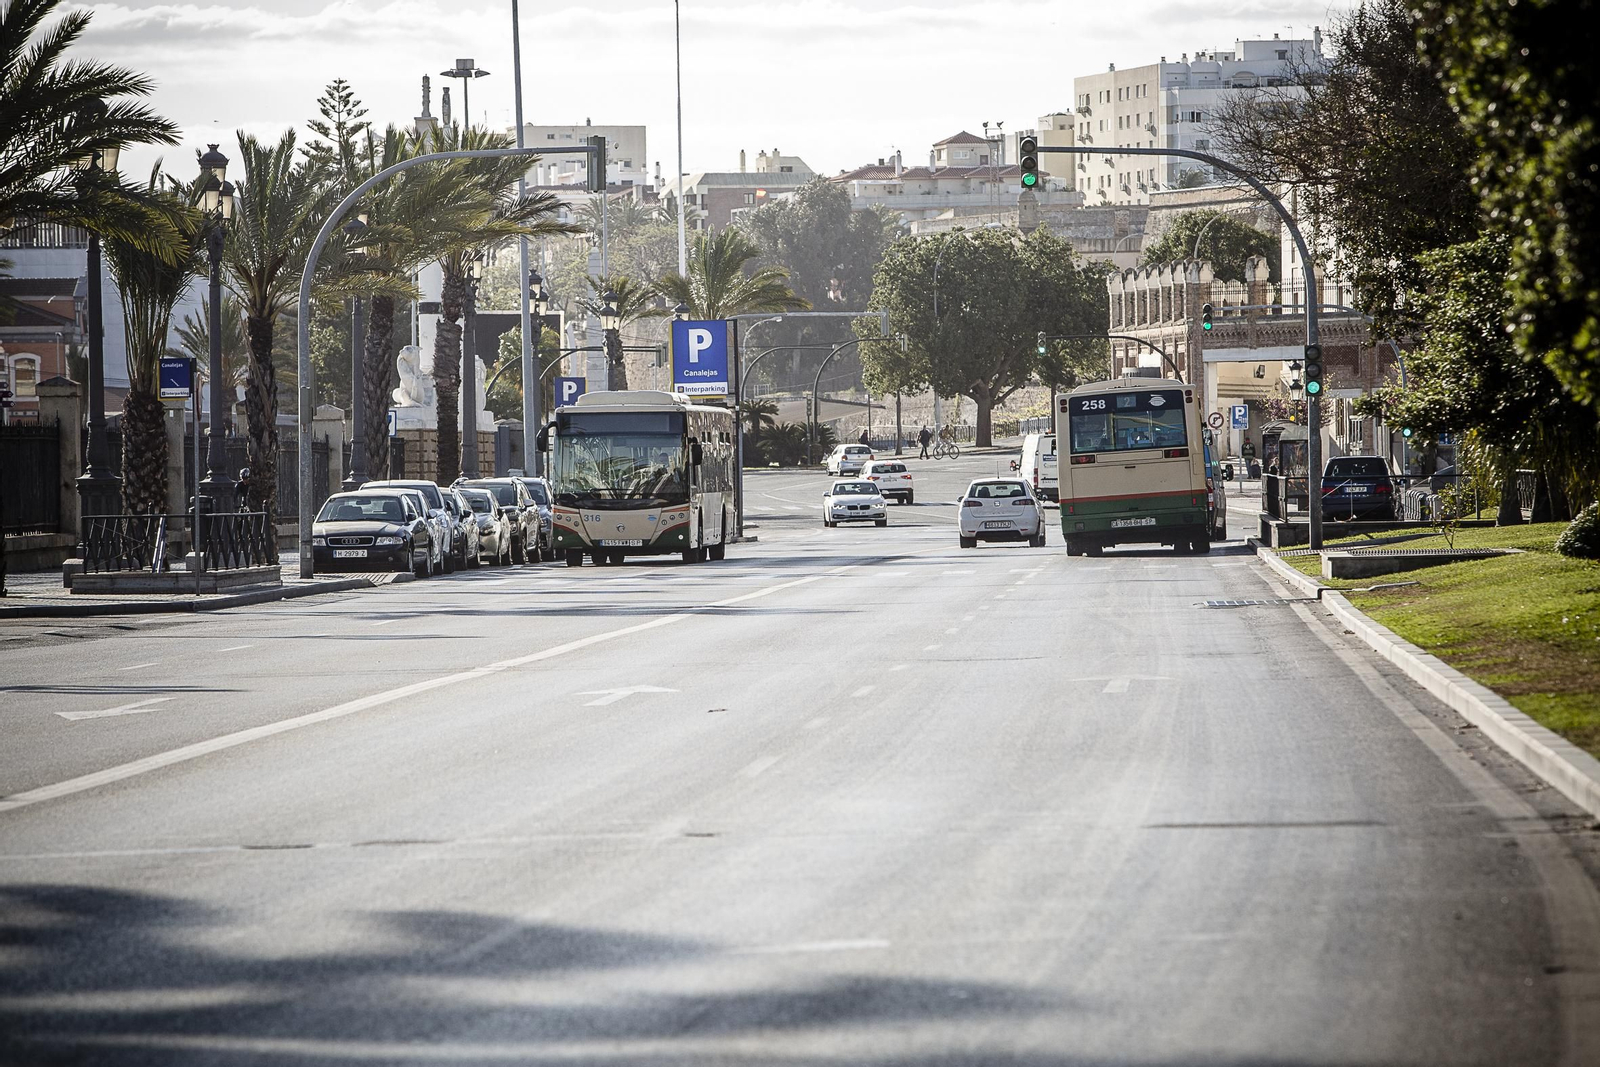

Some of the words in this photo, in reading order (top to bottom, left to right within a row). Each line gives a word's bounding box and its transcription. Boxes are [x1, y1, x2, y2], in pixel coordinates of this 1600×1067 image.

[688, 328, 713, 362] P
[683, 369, 719, 377] Canalejas
[563, 381, 577, 402] P
[685, 385, 726, 393] Interparking
[1082, 399, 1106, 411] 258
[1124, 397, 1131, 408] 2
[1235, 407, 1245, 419] P
[583, 514, 601, 522] 316
